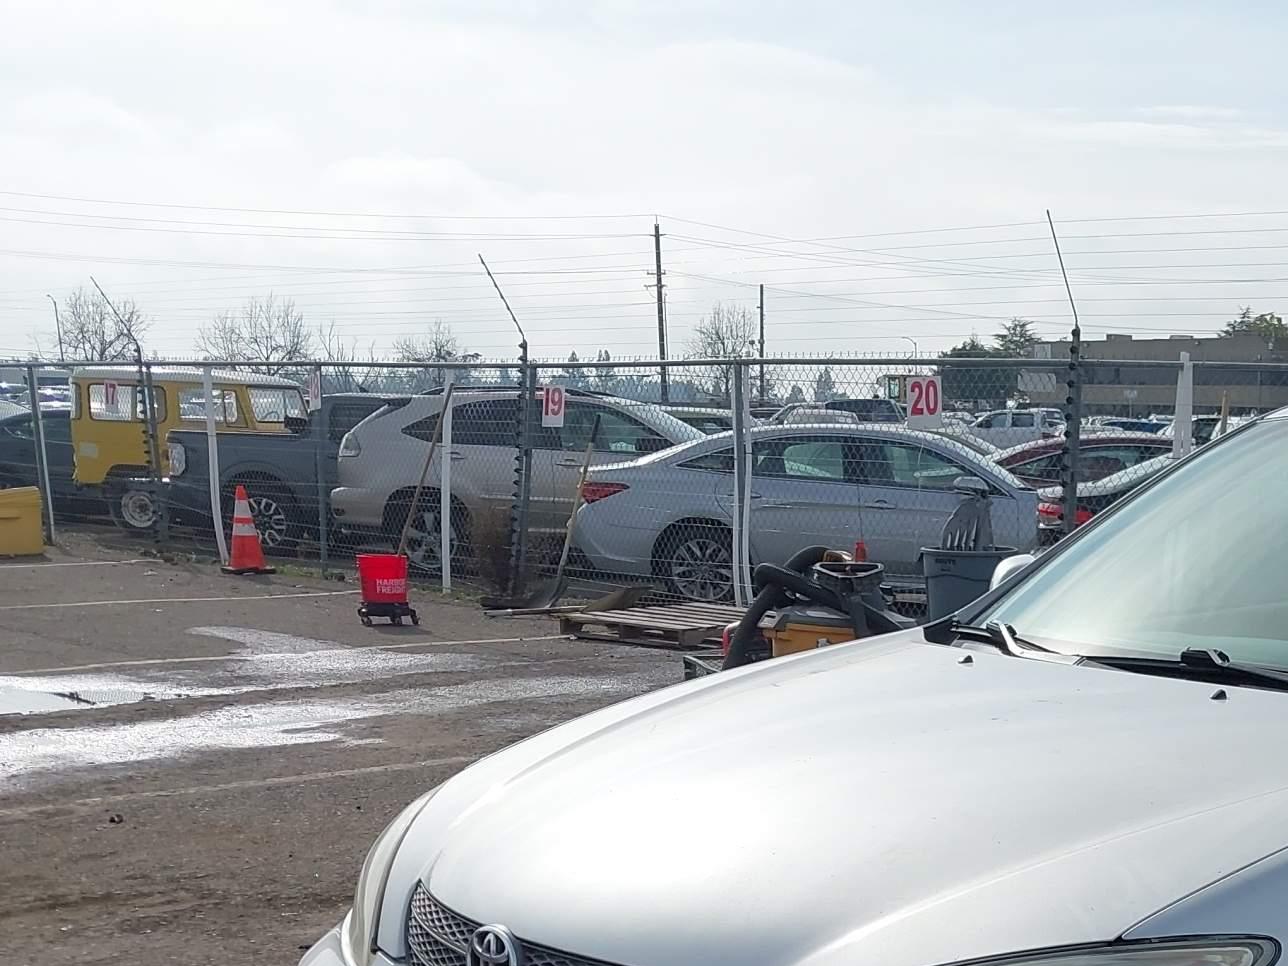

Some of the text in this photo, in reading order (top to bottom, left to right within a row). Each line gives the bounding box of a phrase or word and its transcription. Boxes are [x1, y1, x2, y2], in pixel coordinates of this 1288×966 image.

[105, 383, 116, 405] 17
[544, 387, 563, 416] 19
[910, 380, 939, 416] 20
